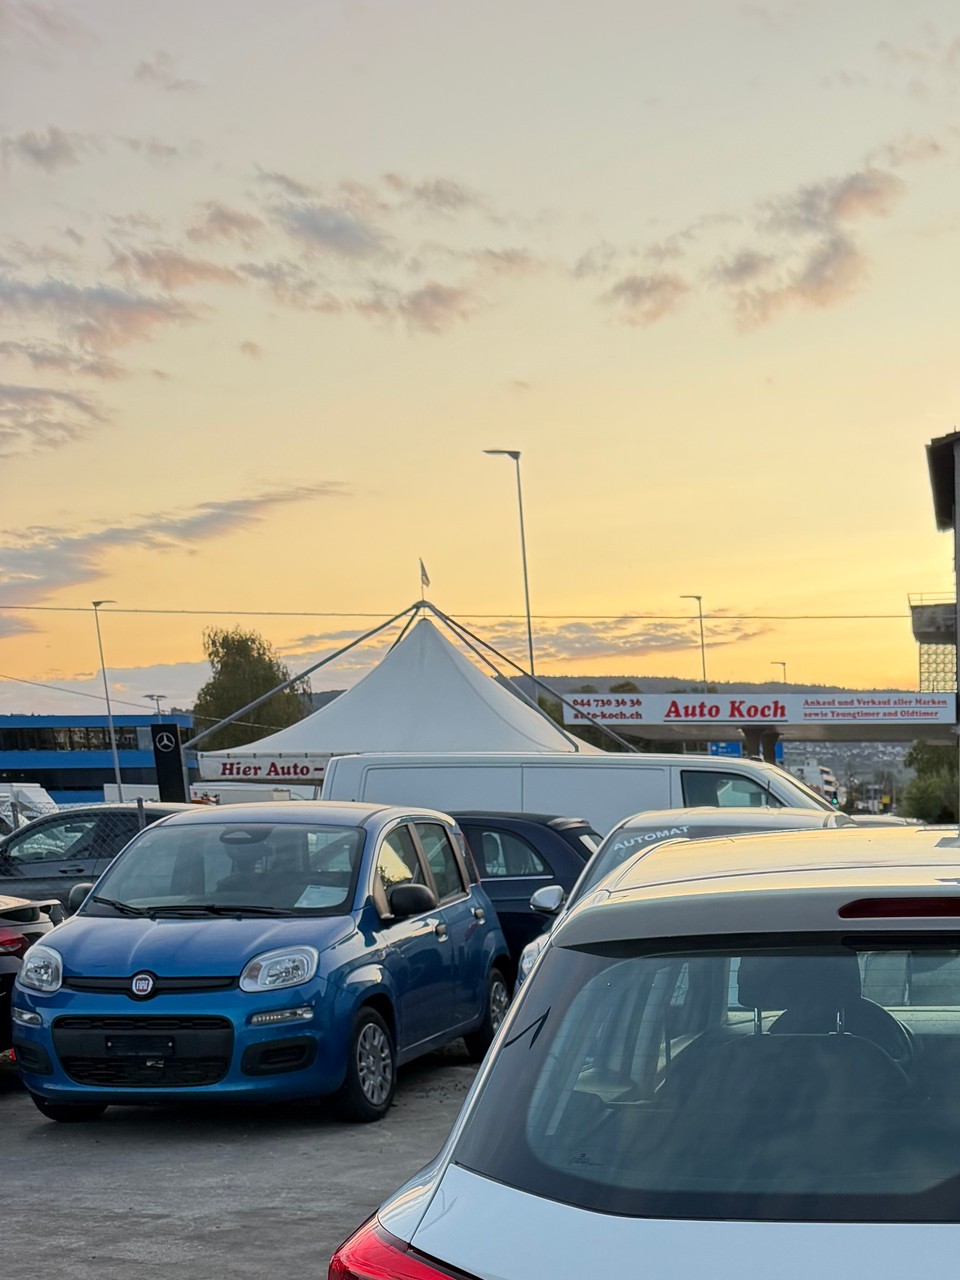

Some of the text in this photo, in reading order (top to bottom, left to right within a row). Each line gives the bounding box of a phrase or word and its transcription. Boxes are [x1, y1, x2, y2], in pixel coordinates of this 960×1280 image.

[572, 698, 642, 708] 044 730 36 36
[857, 698, 891, 706] Verkauf
[893, 698, 912, 706] aller
[915, 698, 947, 706] Marken
[663, 701, 787, 718] Auto Koch
[220, 762, 262, 776] Hier
[614, 825, 690, 851] AUTOMAT
